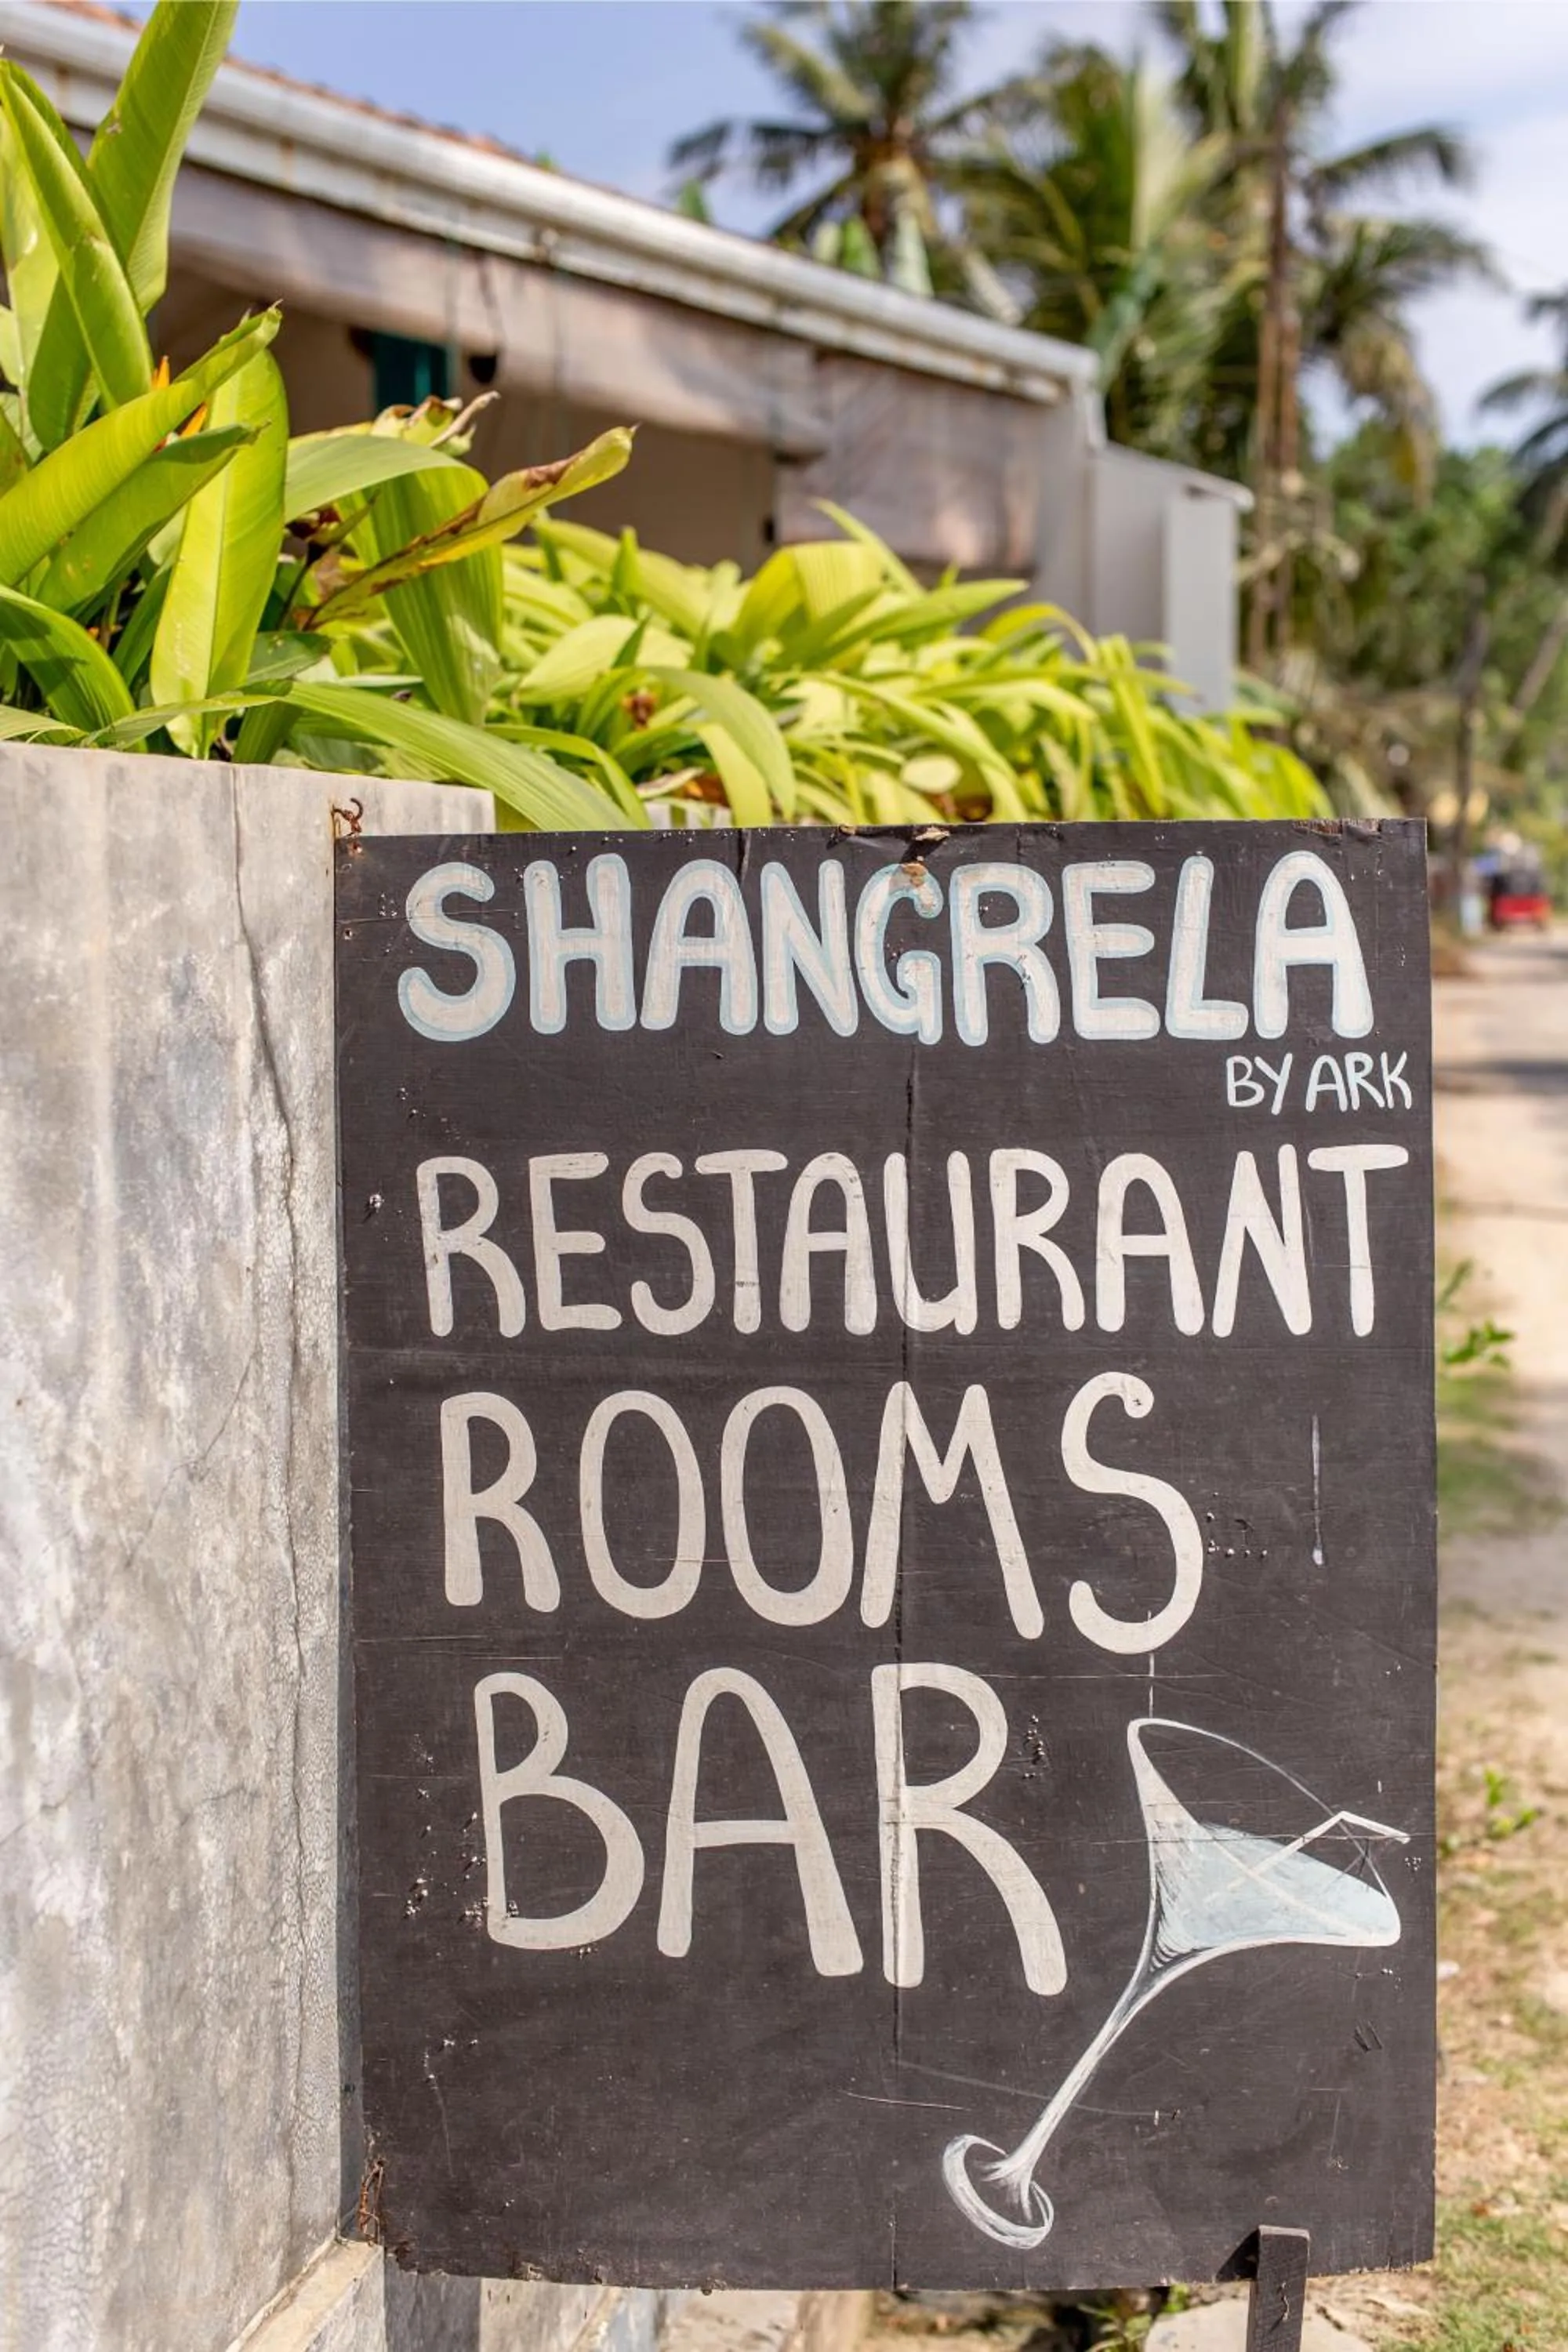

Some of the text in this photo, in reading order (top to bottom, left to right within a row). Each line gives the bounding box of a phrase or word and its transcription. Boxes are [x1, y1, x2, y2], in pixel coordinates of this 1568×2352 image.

[397, 851, 1374, 1047] SHANGRELA
[1226, 1051, 1413, 1116] BY ARK
[416, 1143, 1410, 1338] RESTAURANT
[440, 1371, 1205, 1655] ROOMS
[474, 1661, 1069, 1997] BAR
